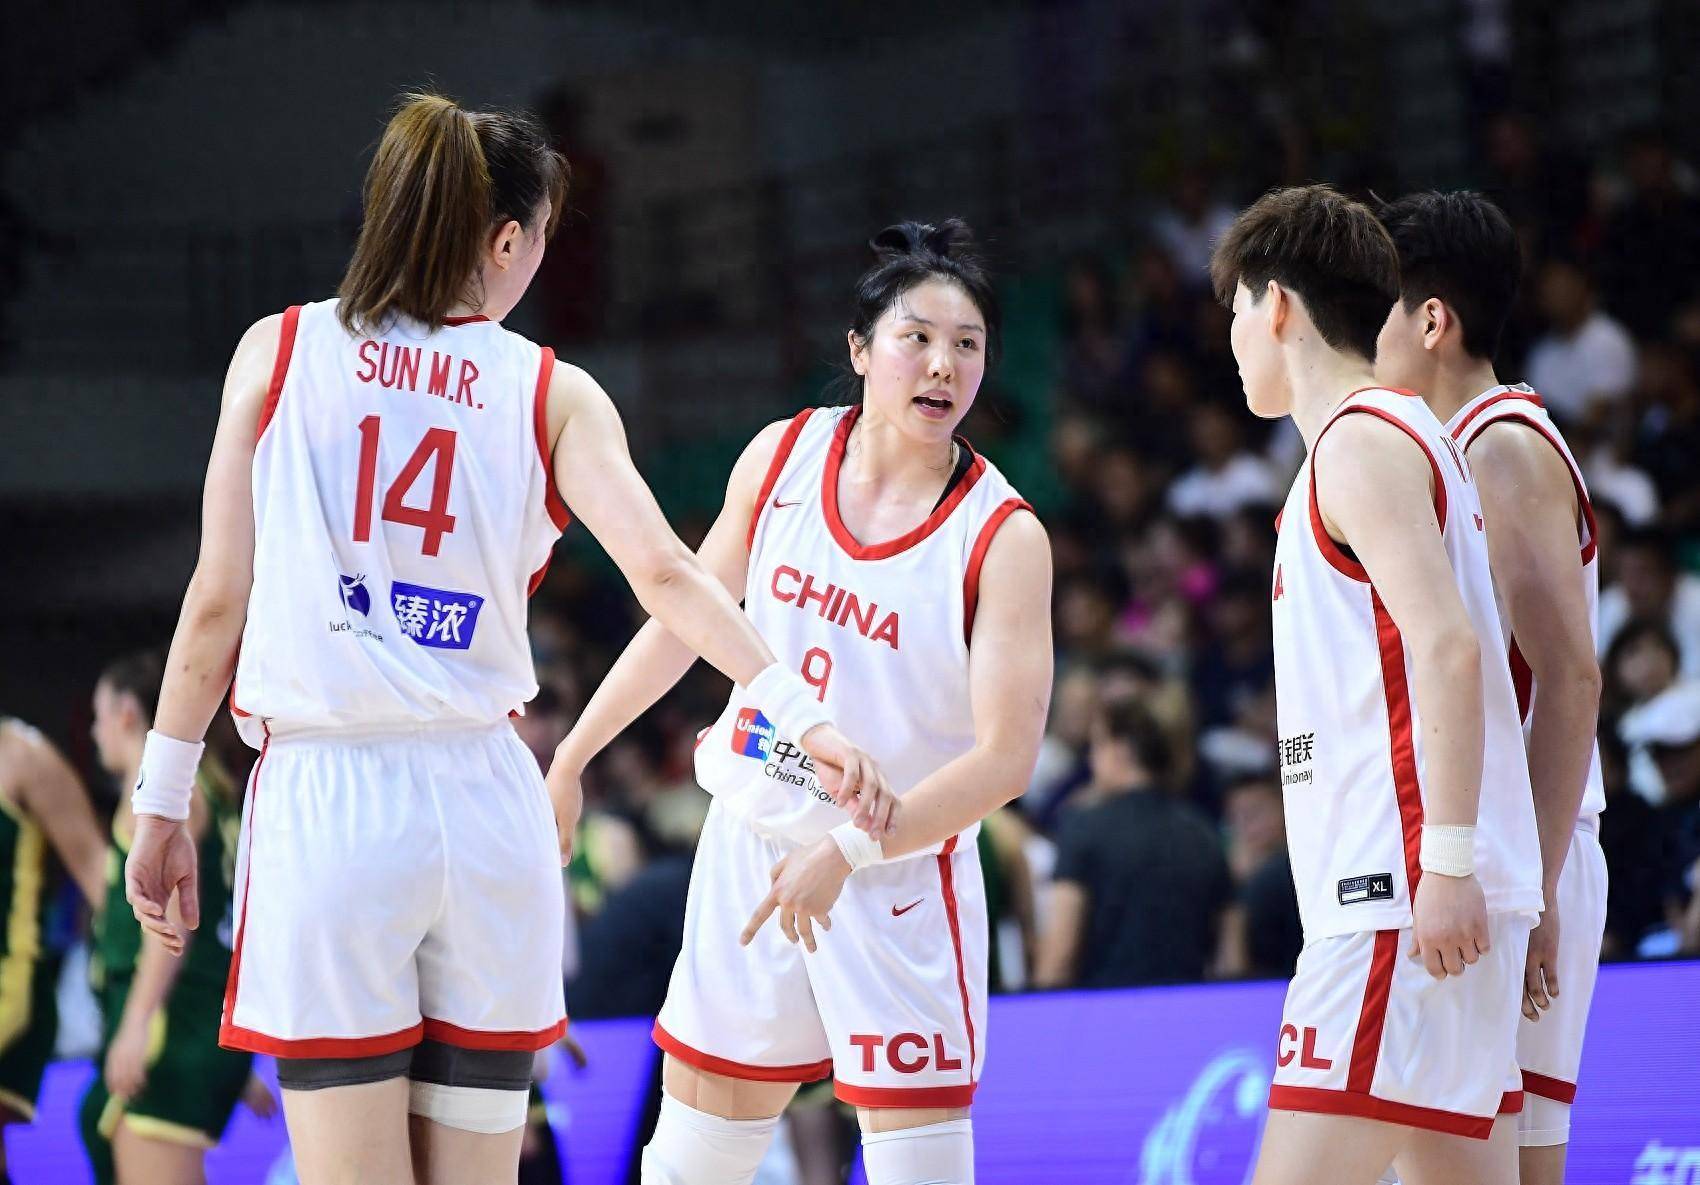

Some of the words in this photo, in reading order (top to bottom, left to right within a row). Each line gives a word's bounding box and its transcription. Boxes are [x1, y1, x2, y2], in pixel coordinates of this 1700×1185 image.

[356, 340, 422, 392] SUN
[427, 351, 484, 409] M.R.
[352, 414, 457, 557] 14
[771, 564, 899, 650] CHINA
[800, 646, 832, 703] 9
[765, 763, 806, 787] China
[1372, 881, 1387, 892] XL
[849, 1032, 962, 1073] TCL
[1278, 1024, 1332, 1070] CL
